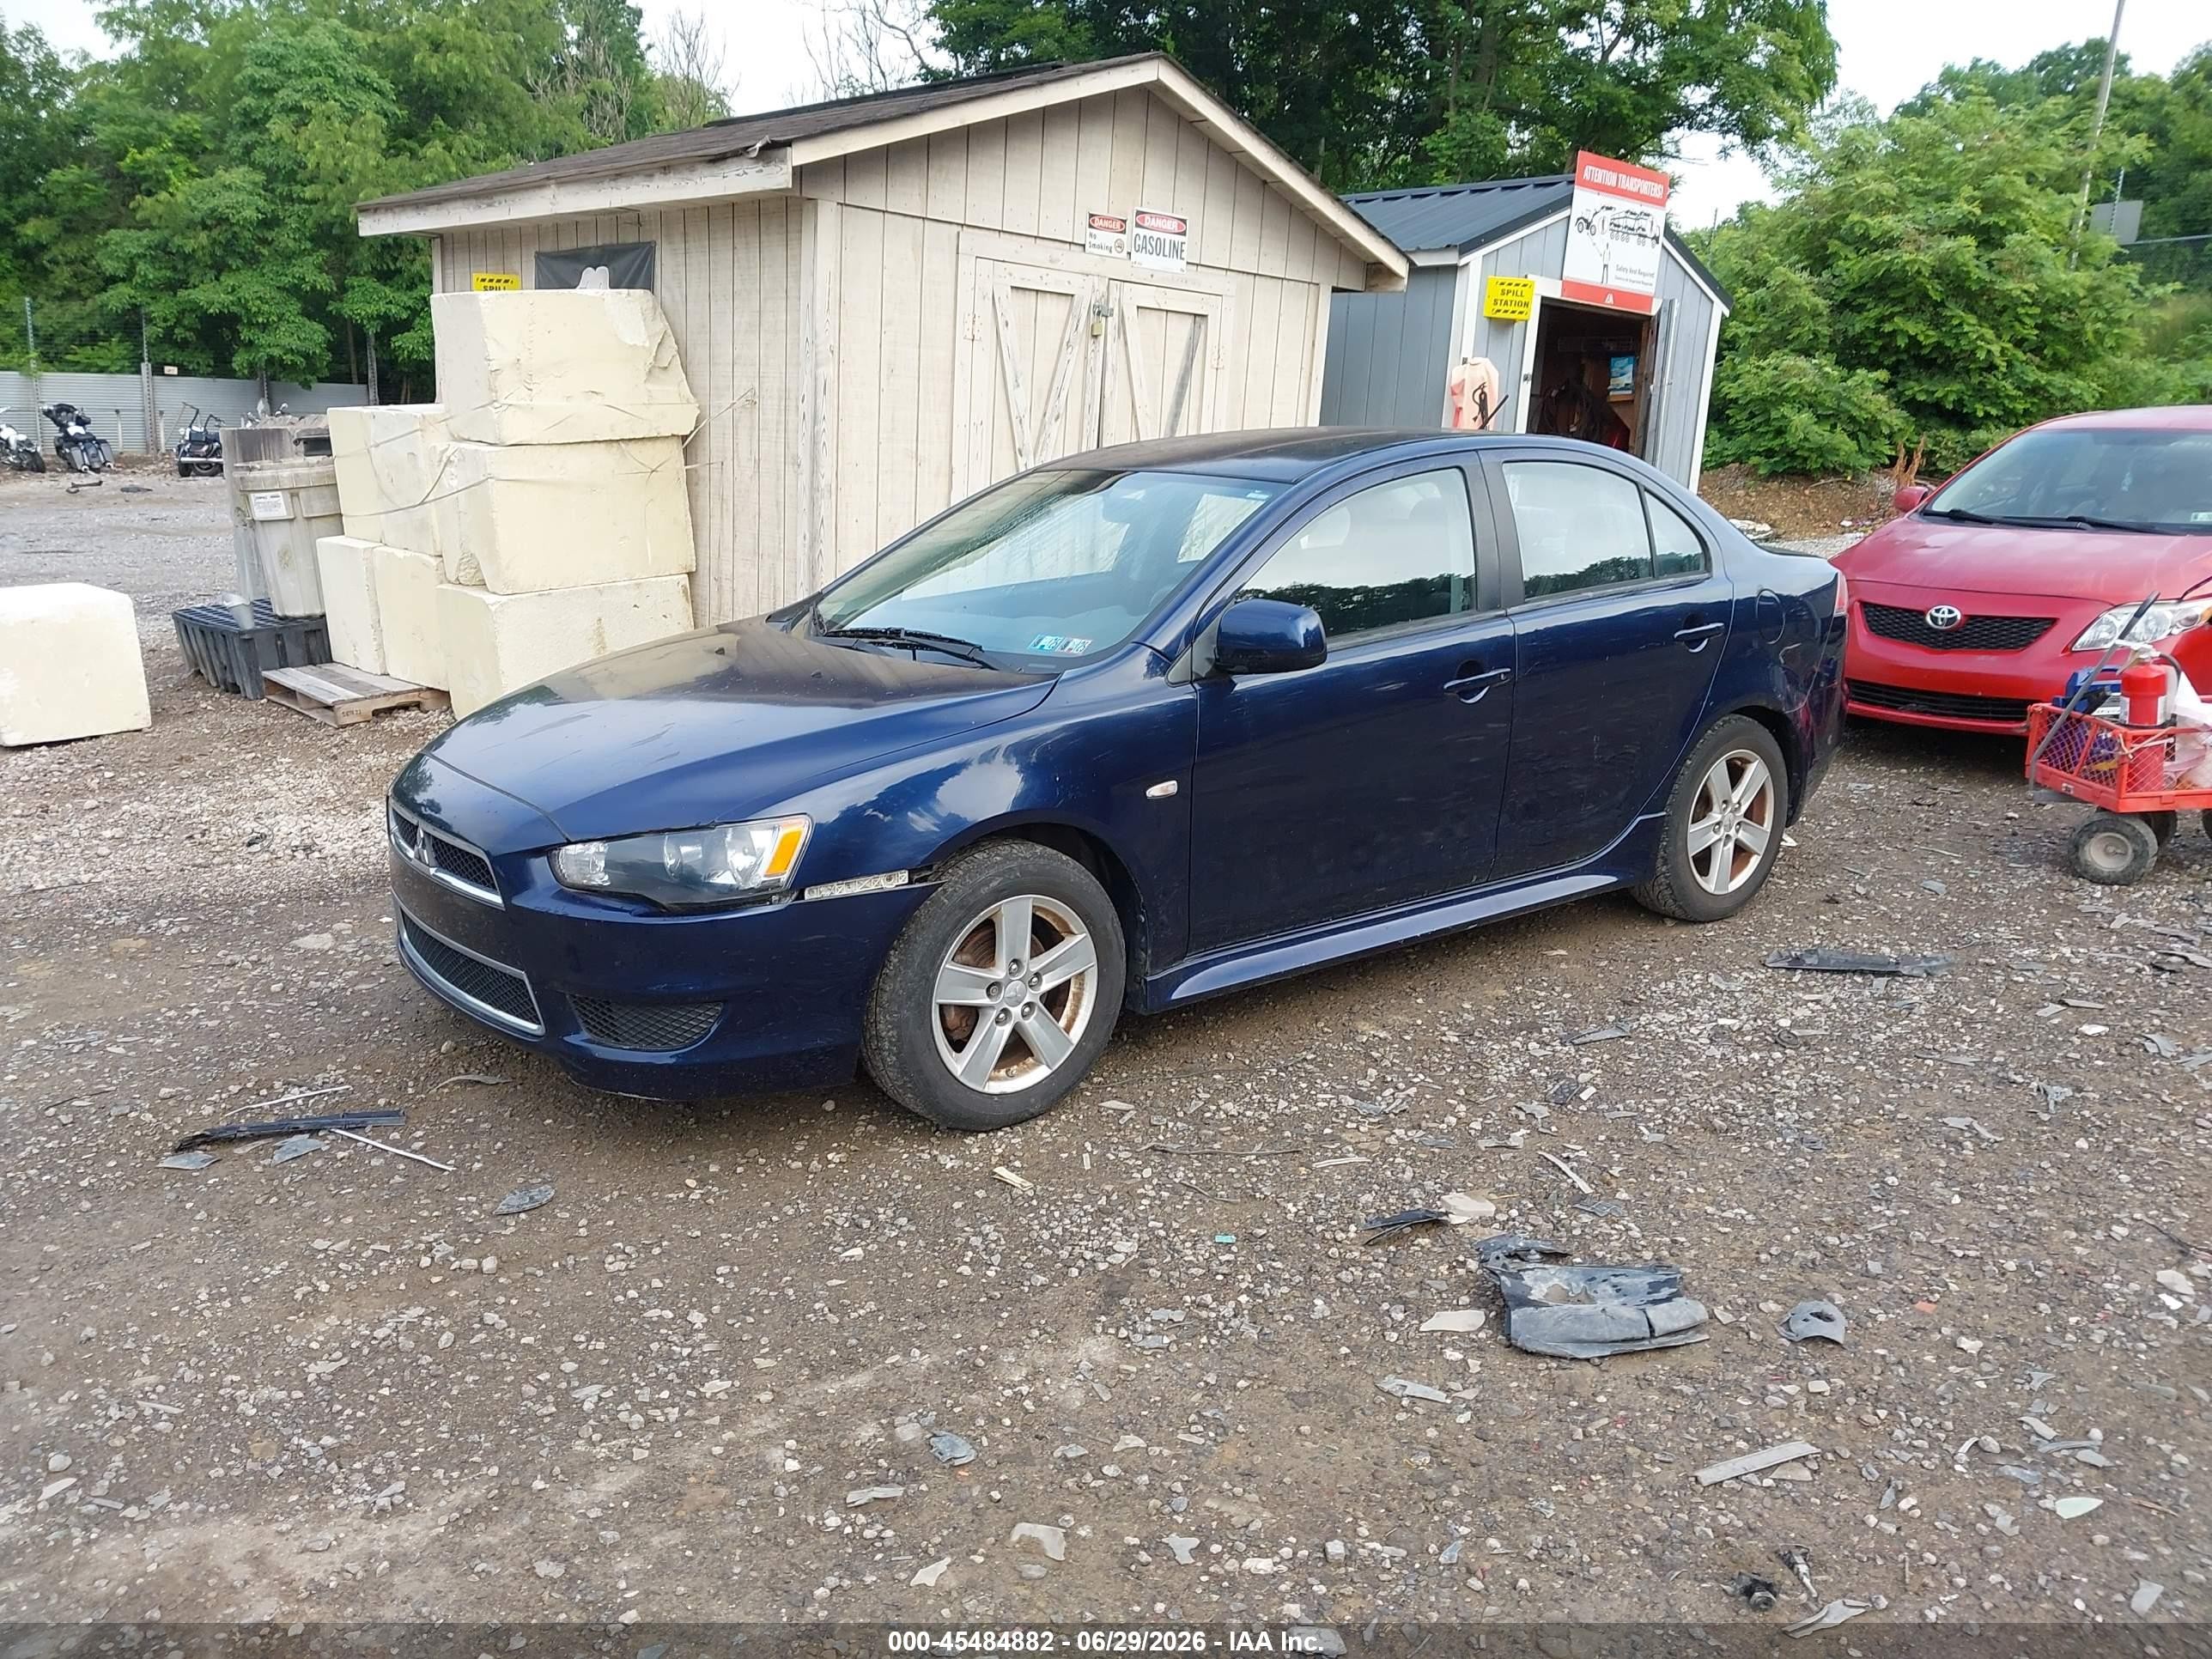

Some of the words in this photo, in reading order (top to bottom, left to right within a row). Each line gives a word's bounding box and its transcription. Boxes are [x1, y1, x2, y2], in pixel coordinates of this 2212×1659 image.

[1583, 165, 1618, 187] ATTENTION
[1618, 173, 1664, 199] TRANSPORTERS!
[1094, 216, 1121, 230] DANGER
[1144, 216, 1178, 231] DANGER
[1089, 231, 1097, 240] No
[1088, 240, 1113, 254] Smoking
[1133, 233, 1186, 260] GASOLINE
[1500, 288, 1525, 297] SPILL
[1493, 298, 1530, 308] STATION
